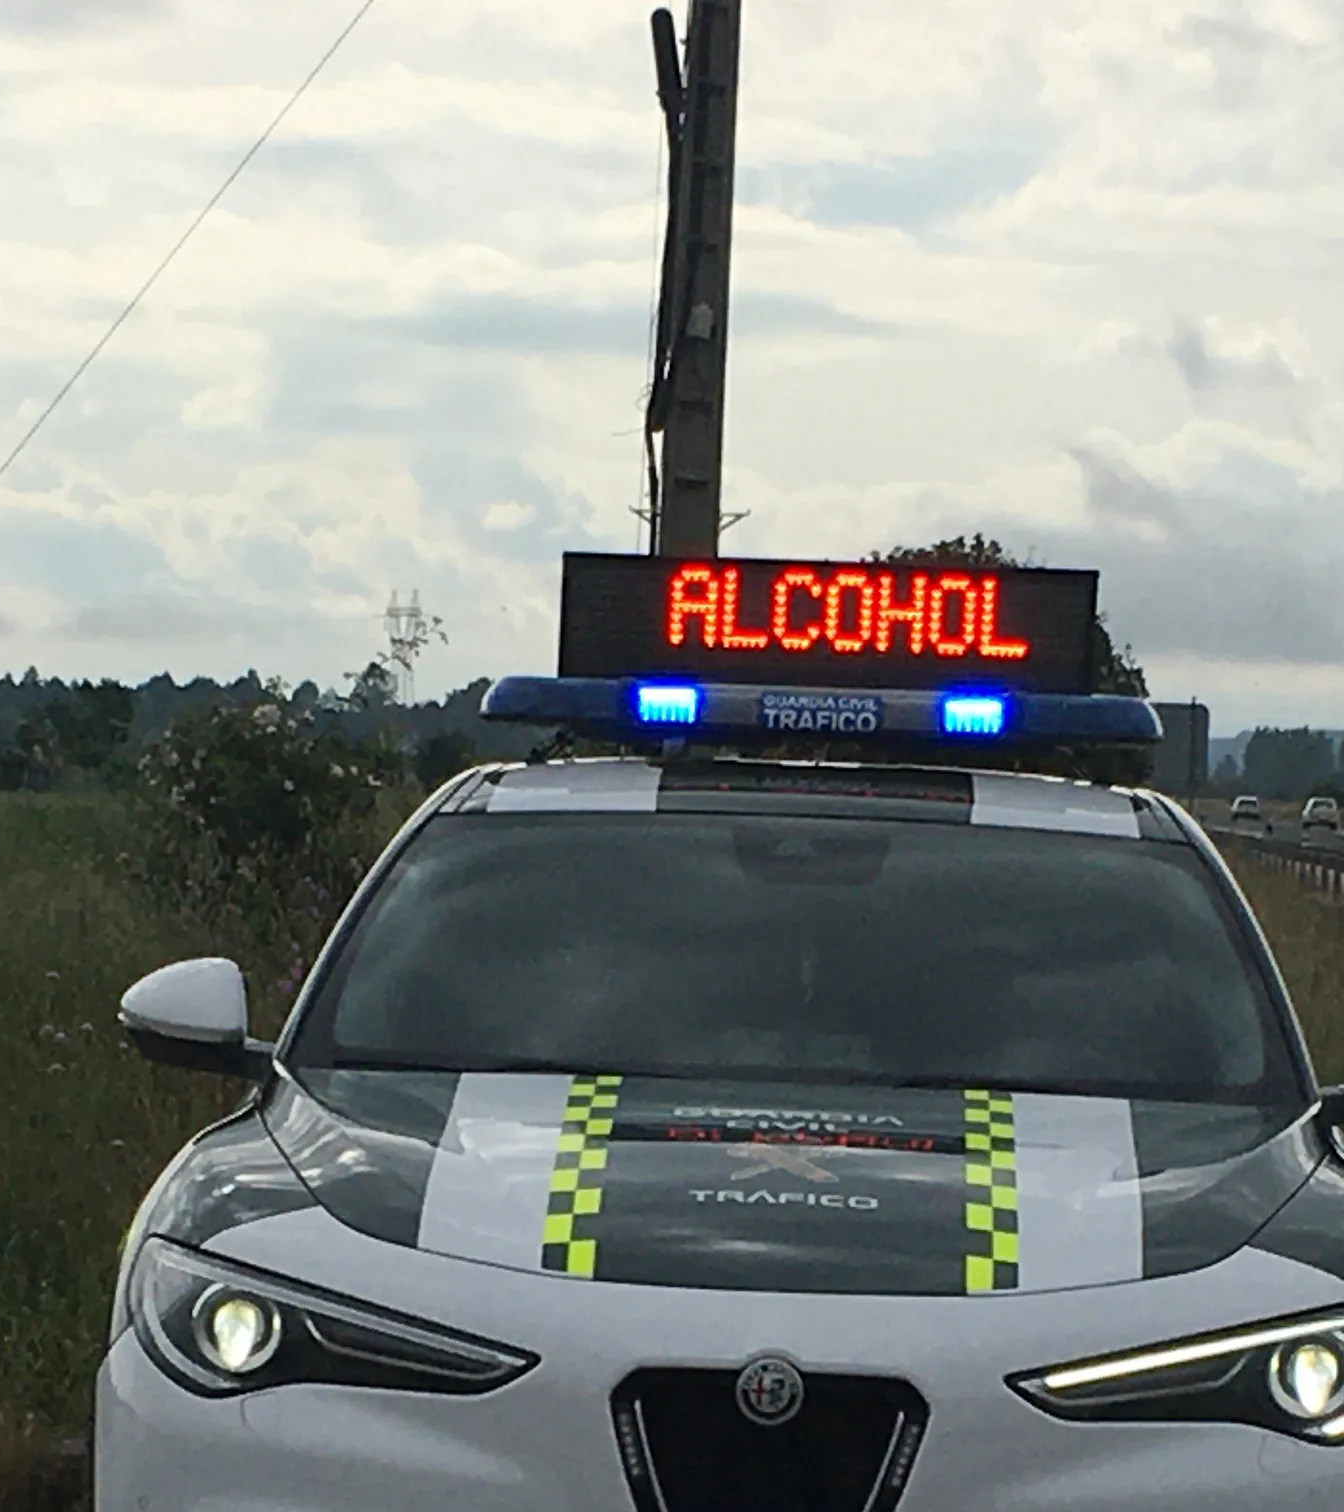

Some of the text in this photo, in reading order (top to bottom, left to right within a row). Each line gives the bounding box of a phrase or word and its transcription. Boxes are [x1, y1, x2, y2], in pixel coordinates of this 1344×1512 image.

[666, 562, 1030, 659] ALCOHOL
[763, 694, 836, 709] GUARDIA
[763, 709, 877, 732] TRAFICO
